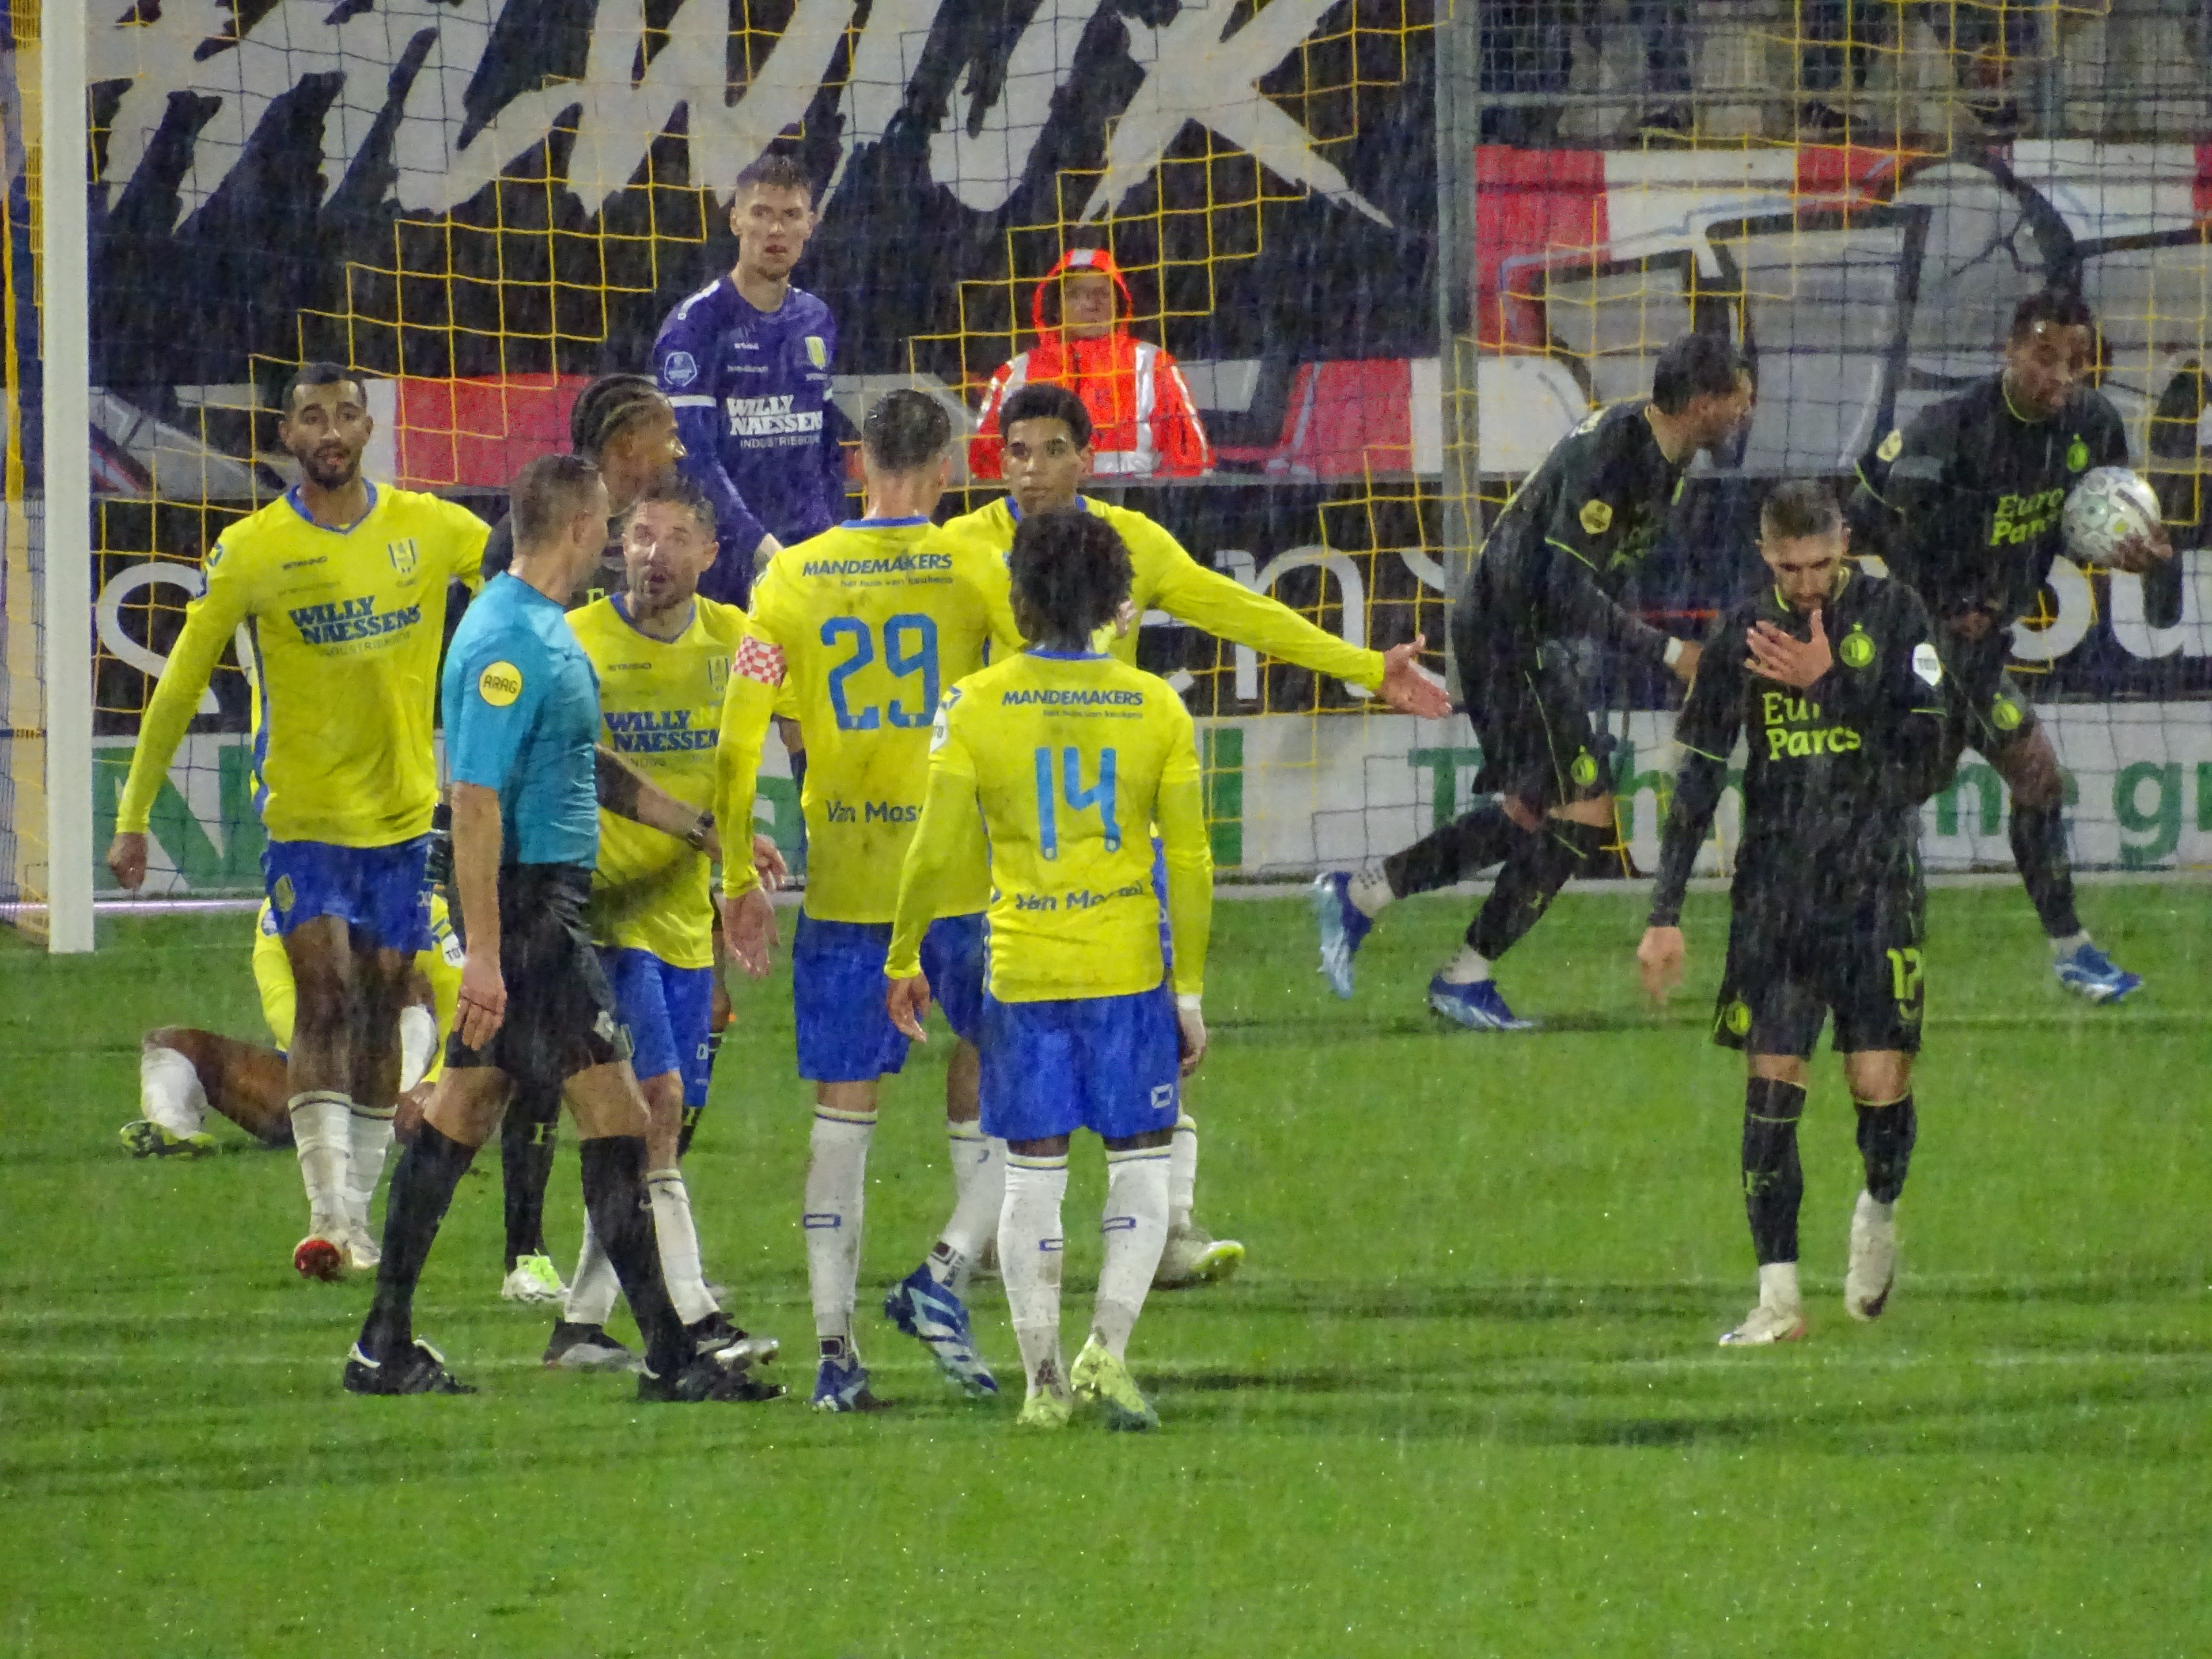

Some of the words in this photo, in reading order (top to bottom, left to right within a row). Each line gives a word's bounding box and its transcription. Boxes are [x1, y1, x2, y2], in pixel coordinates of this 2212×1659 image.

[726, 395, 794, 416] WILLY
[802, 552, 953, 577] MANDEMAKERS
[289, 595, 375, 627] WILLY
[300, 603, 421, 645] NAESSENS
[820, 613, 941, 730] 29
[483, 675, 517, 695] ARAG
[1002, 690, 1143, 706] MANDEMAKERS
[604, 710, 691, 732] WILLY
[1766, 726, 1862, 760] Parcs
[825, 799, 855, 823] Van
[1034, 747, 1120, 859] 14
